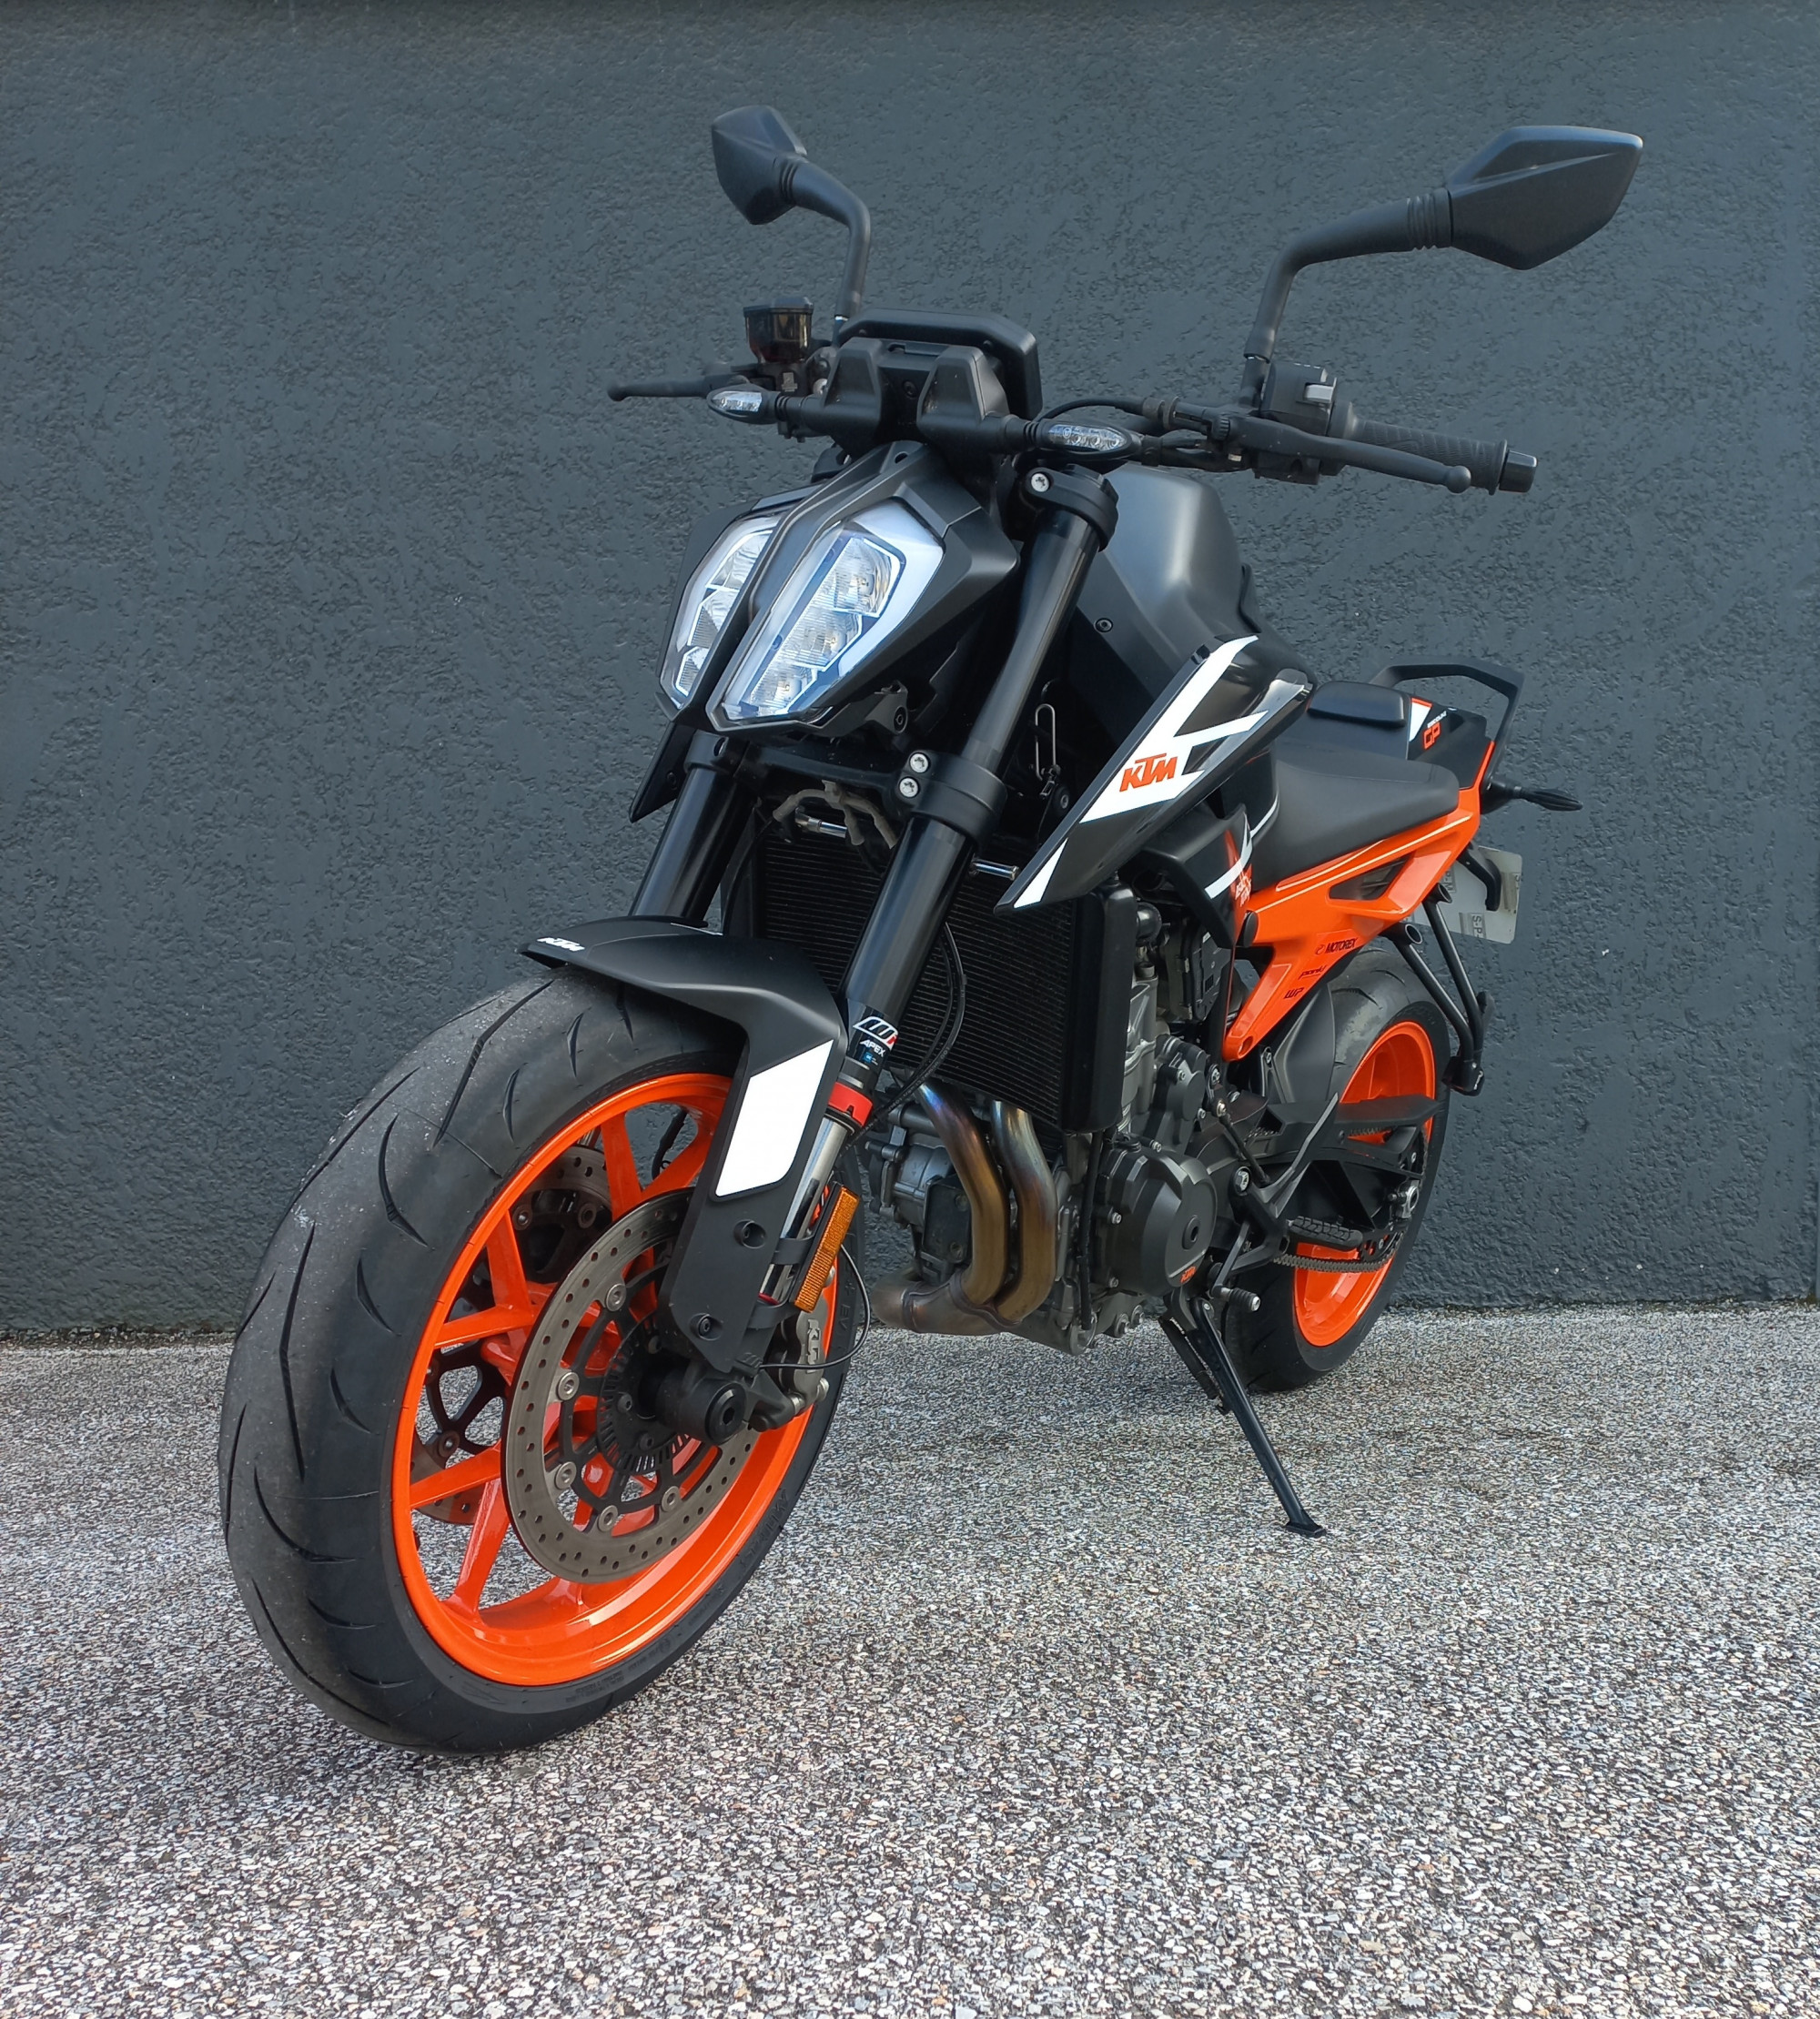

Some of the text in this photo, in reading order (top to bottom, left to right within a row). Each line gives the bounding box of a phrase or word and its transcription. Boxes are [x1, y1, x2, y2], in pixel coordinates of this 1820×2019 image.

[1423, 722, 1441, 750] GP
[1119, 752, 1178, 792] KTM
[536, 936, 585, 952] KTM
[1325, 937, 1359, 954] MOTOREX
[859, 1039, 885, 1057] APEX
